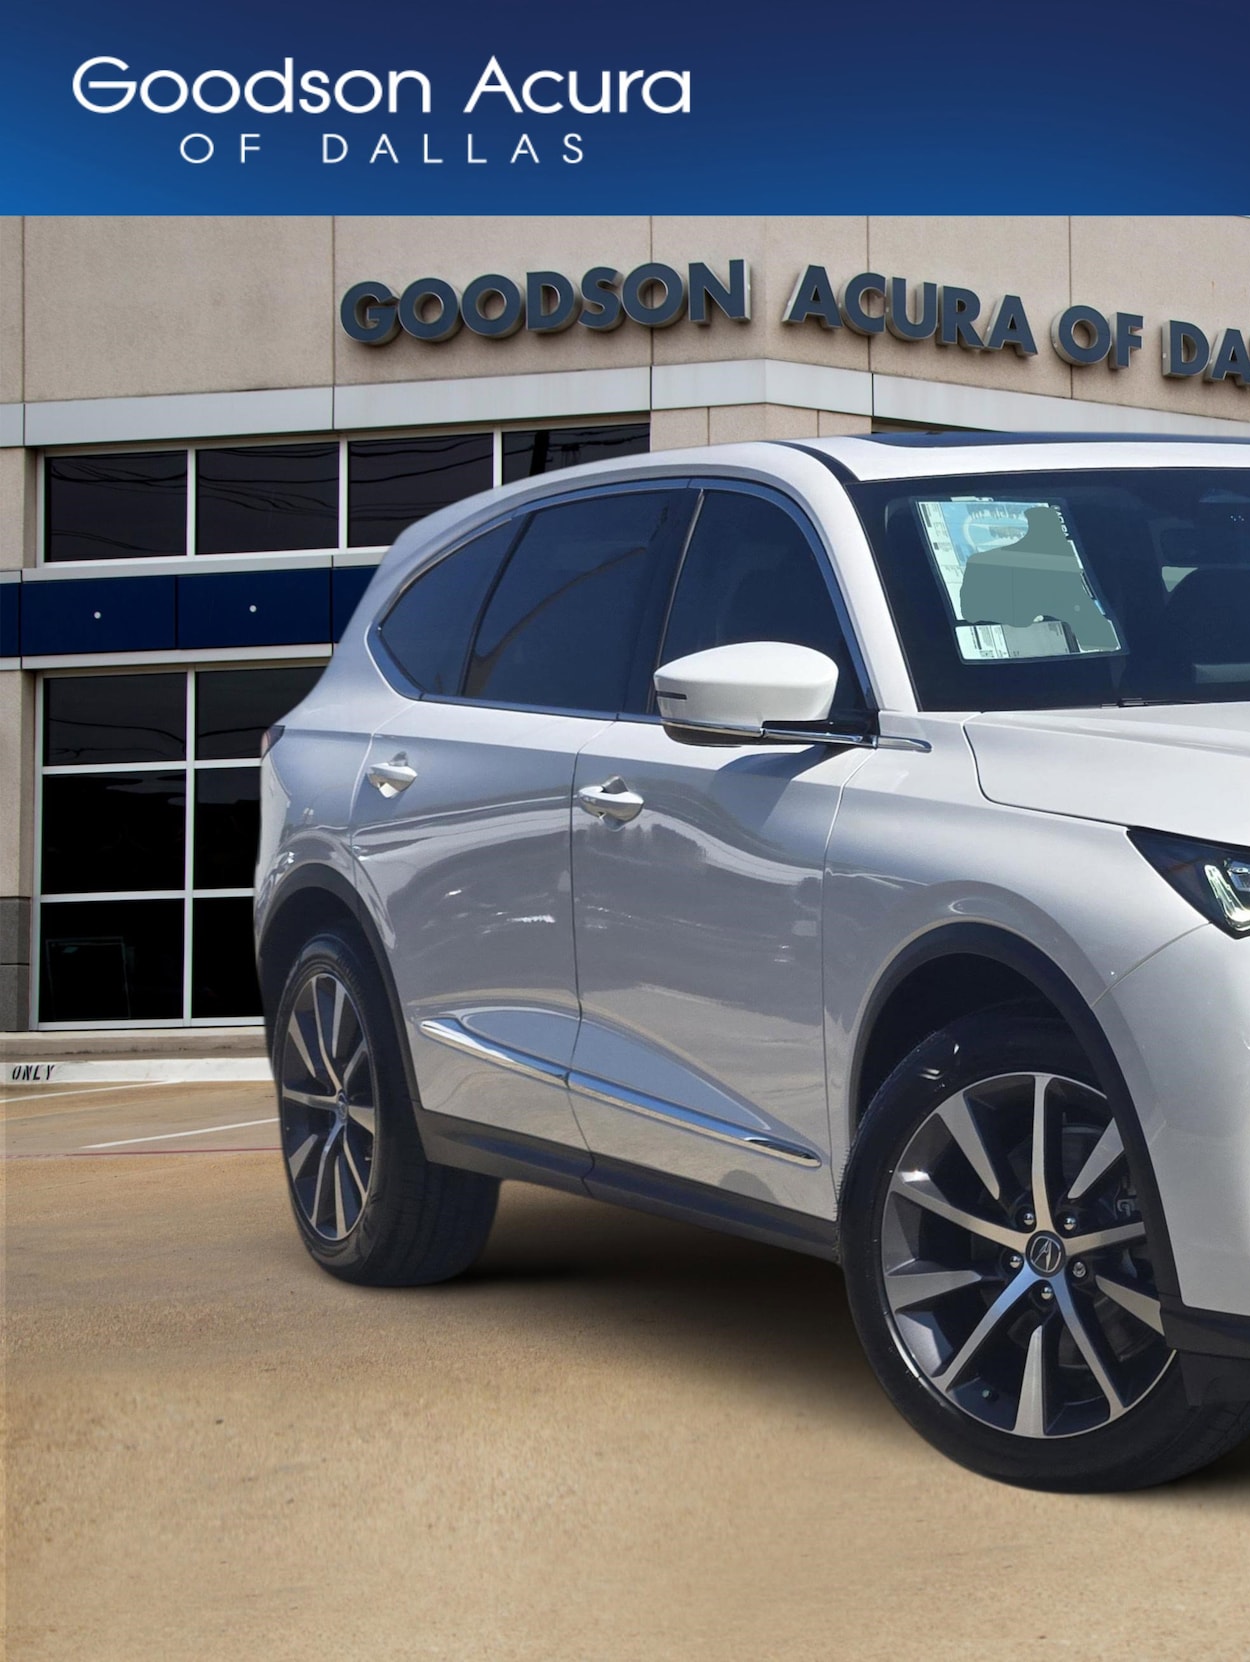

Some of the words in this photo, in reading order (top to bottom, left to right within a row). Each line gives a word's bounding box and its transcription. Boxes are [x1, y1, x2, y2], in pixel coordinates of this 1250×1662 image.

[340, 258, 751, 346] GOODSON
[782, 264, 1039, 358] ACURA
[1051, 304, 1144, 371] OF
[12, 1064, 55, 1081] ONLY
